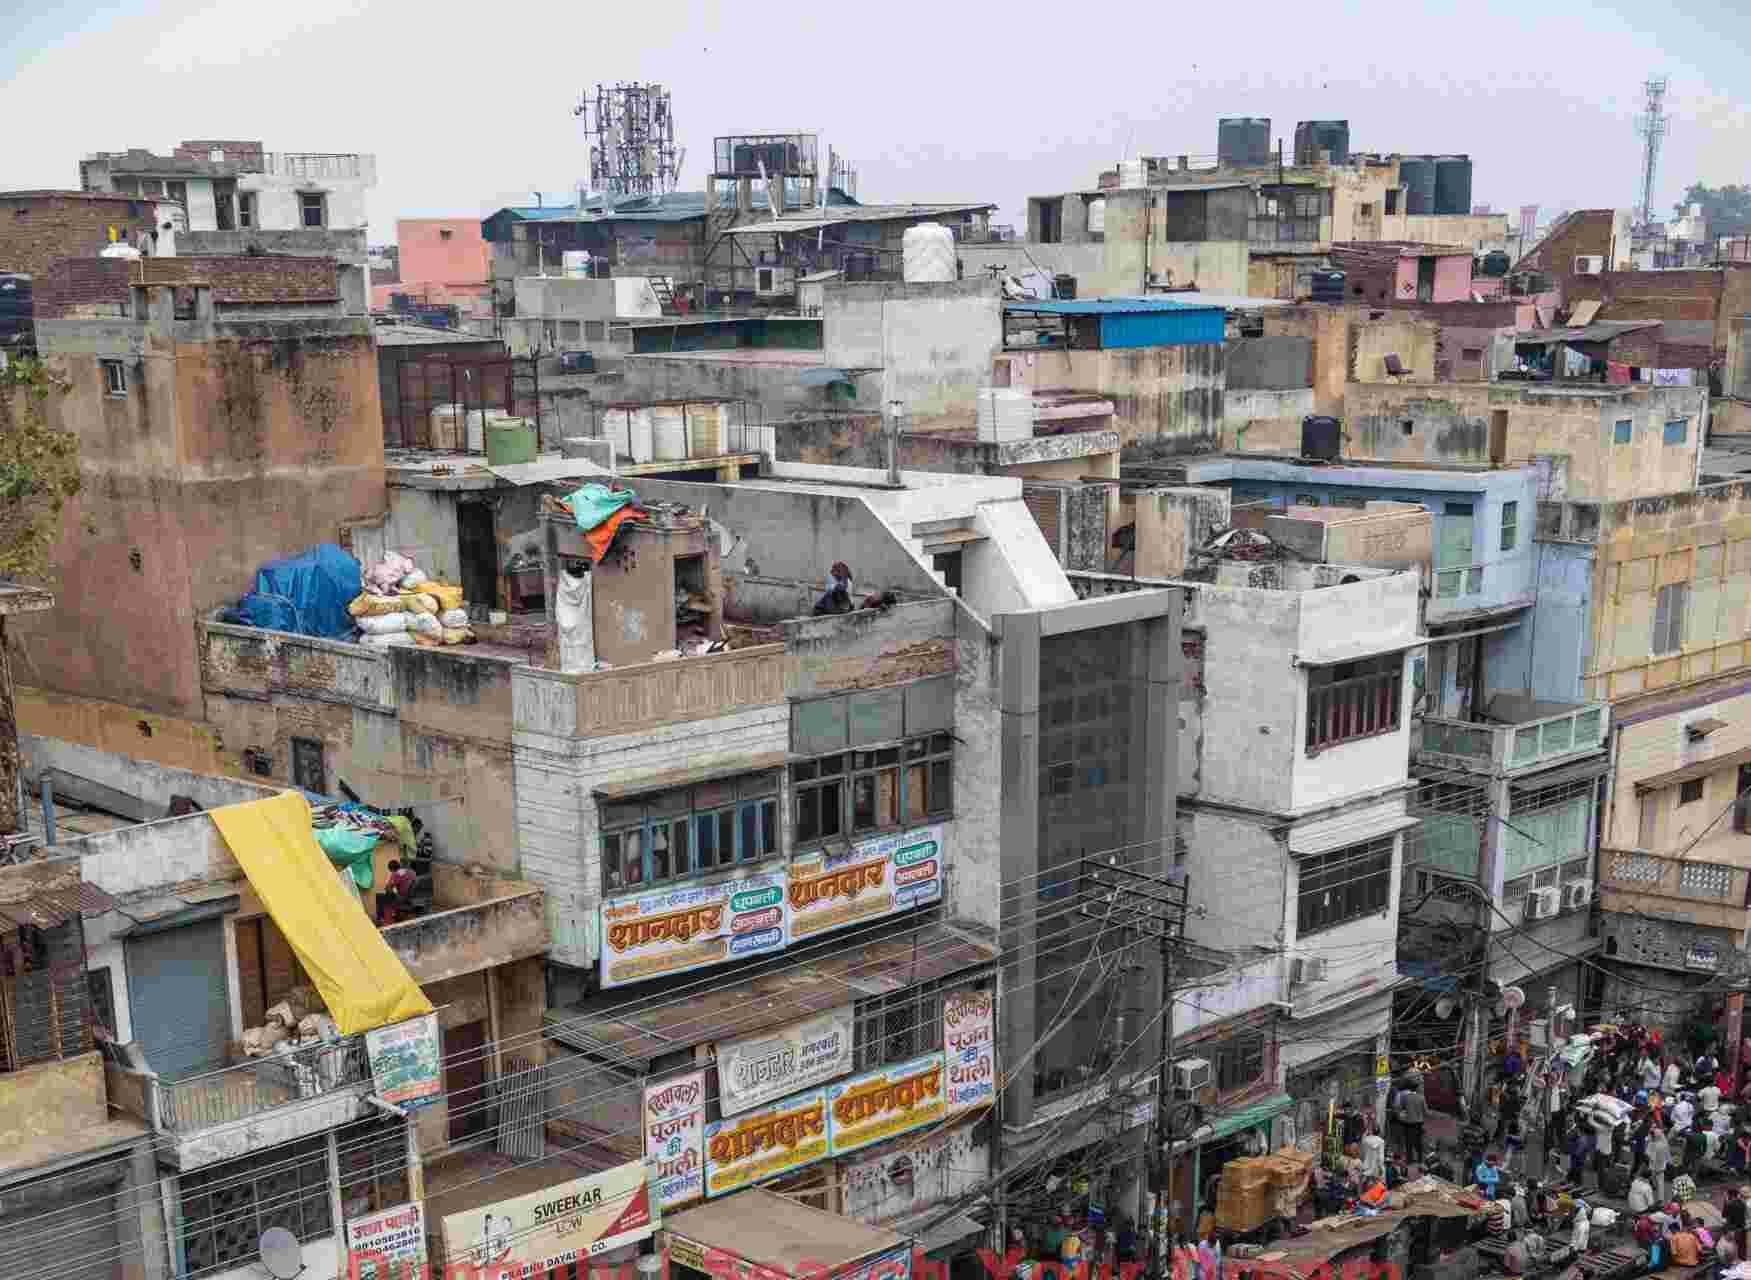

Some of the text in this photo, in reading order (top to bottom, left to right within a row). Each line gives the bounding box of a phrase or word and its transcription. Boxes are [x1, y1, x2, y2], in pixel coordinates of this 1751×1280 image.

[608, 905, 721, 953] शानदार
[534, 1188, 602, 1220] SWEEKAR
[546, 1250, 577, 1267] DAYAL
